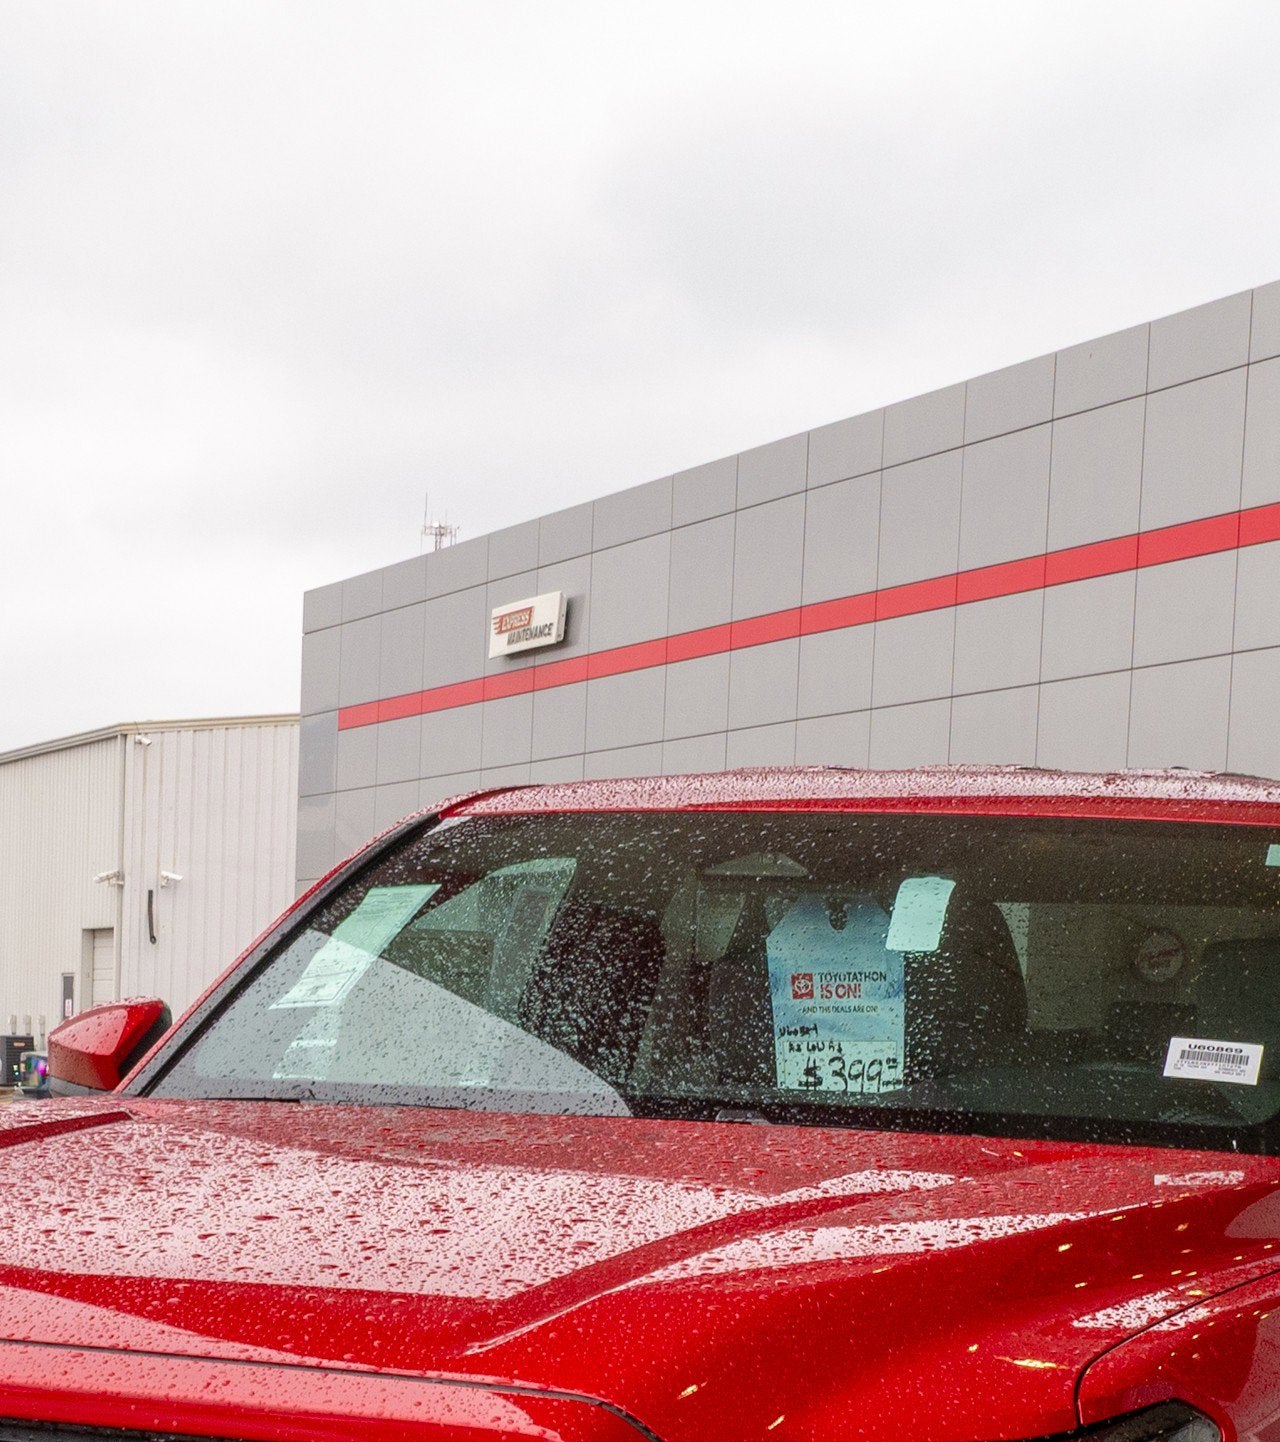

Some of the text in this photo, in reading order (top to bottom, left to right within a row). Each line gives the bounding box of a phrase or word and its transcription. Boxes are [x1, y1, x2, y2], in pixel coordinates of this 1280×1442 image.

[506, 622, 554, 646] MAINTENANCE
[819, 971, 887, 984] TOYOTATHON
[820, 984, 862, 999] IS ON!
[802, 1006, 817, 1014] AND
